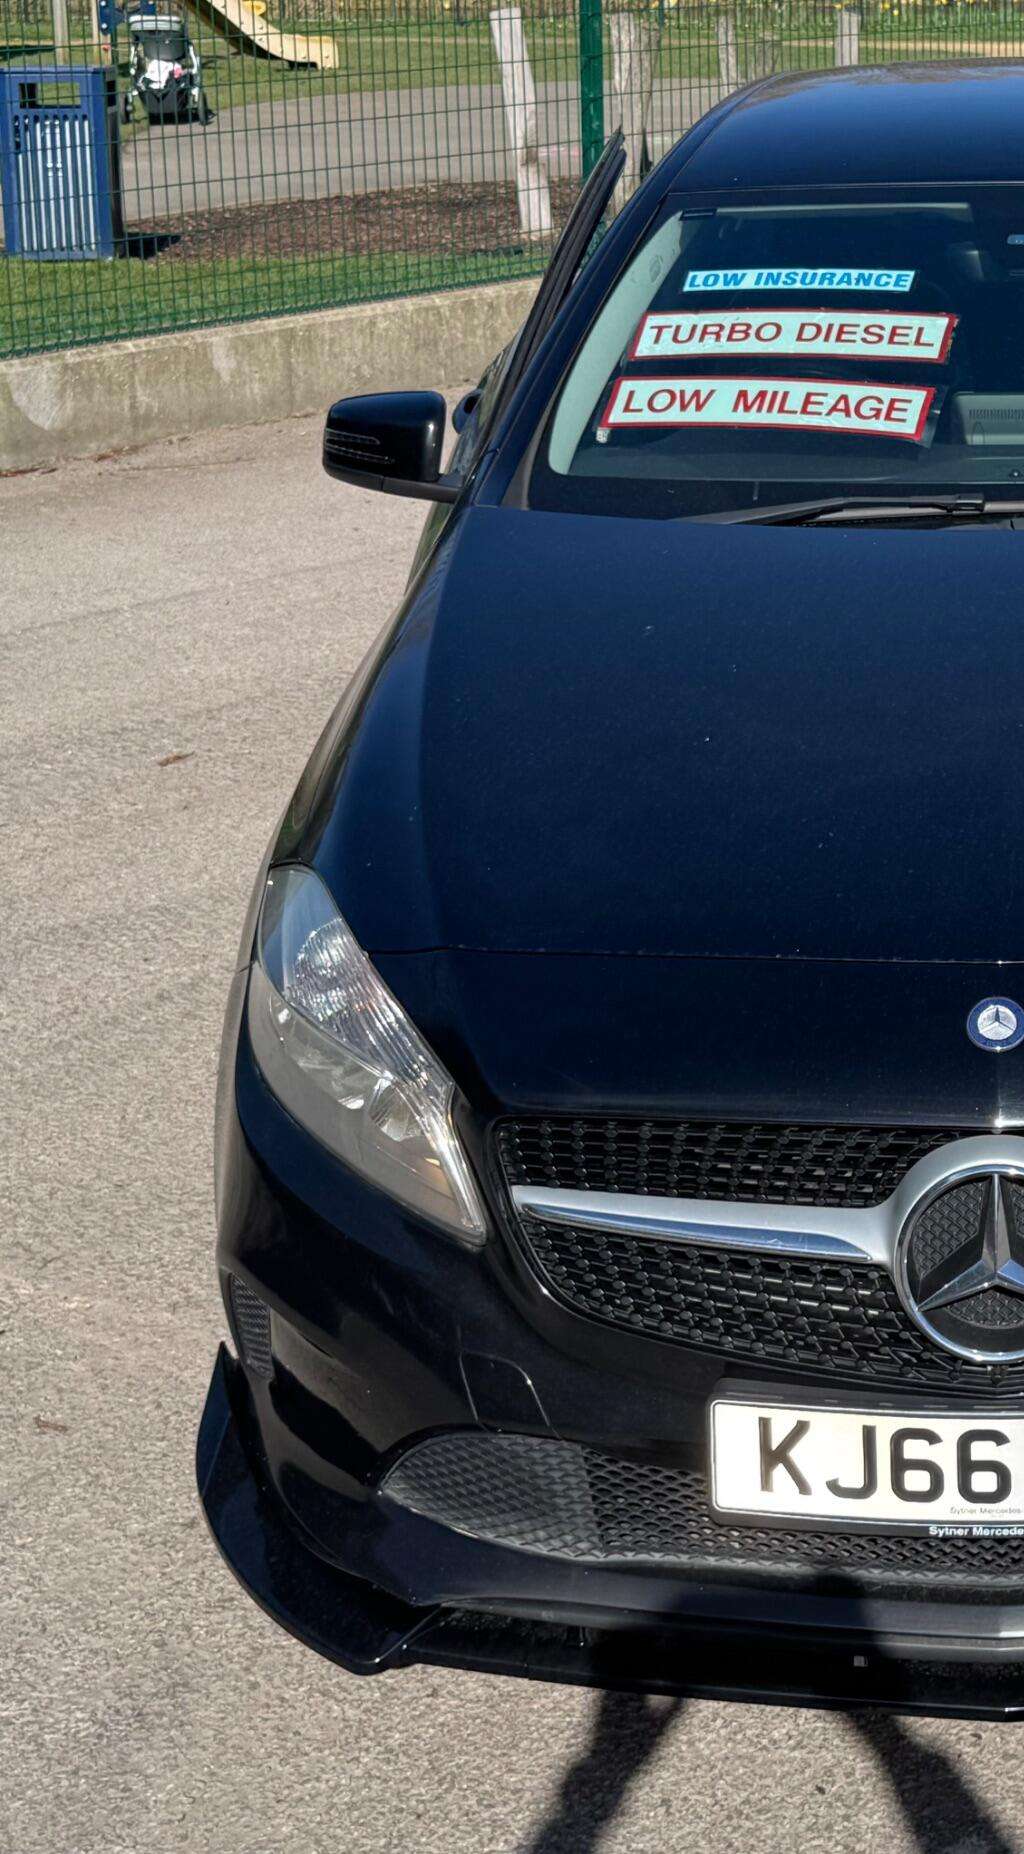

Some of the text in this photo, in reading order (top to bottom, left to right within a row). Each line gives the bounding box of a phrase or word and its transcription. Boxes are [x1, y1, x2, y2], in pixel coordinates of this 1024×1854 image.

[688, 271, 911, 289] LOW INSURANCE
[650, 321, 935, 348] TURBO DIESEL
[622, 388, 912, 424] LOW MILEAGE
[757, 1416, 1013, 1504] KJ66
[928, 1526, 970, 1538] Sytner
